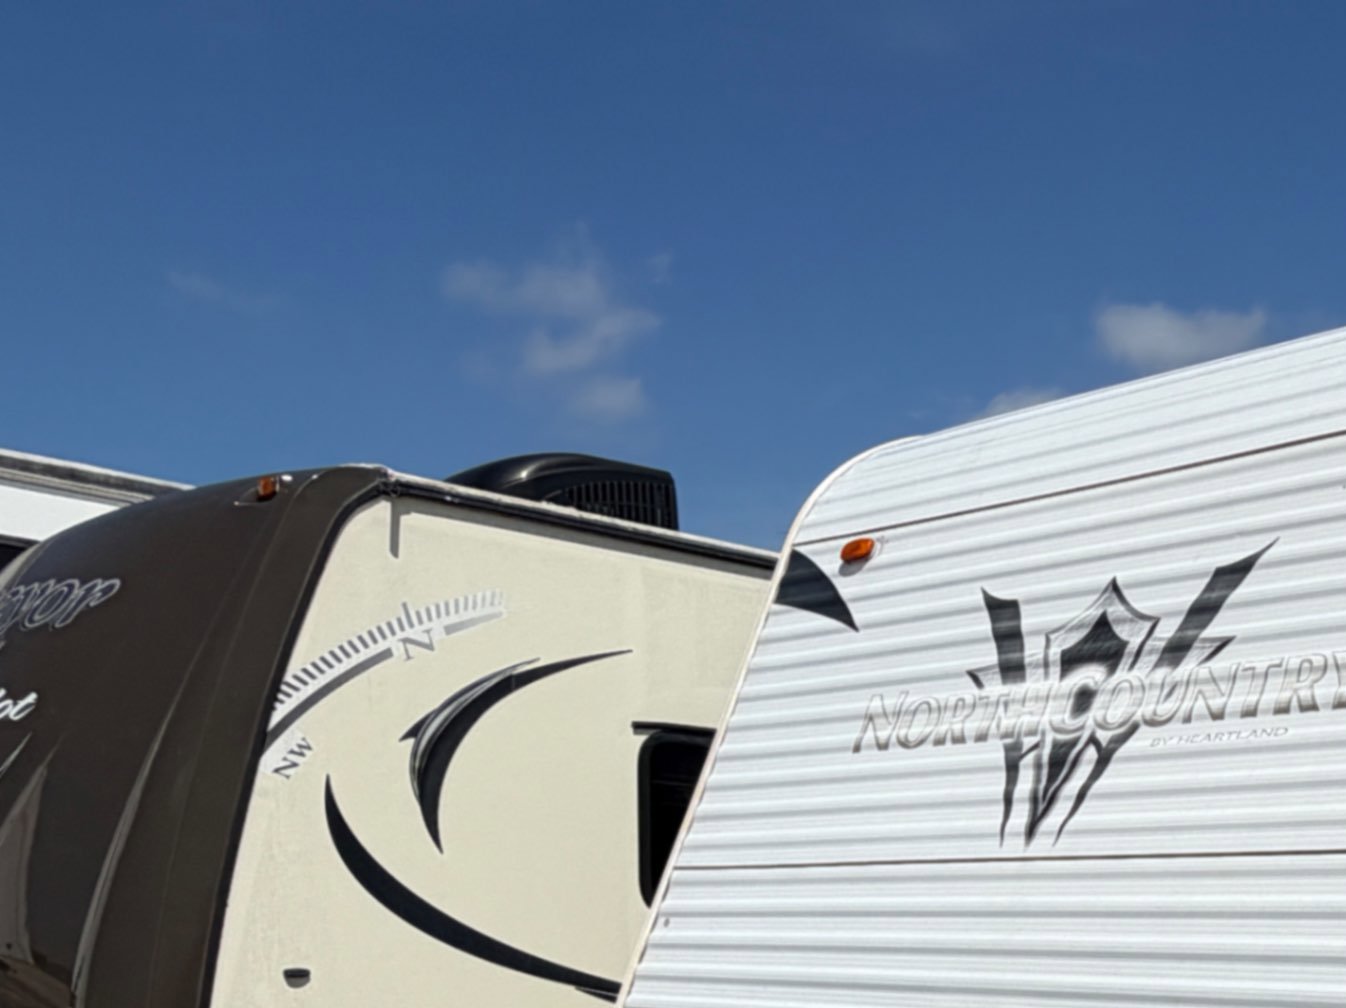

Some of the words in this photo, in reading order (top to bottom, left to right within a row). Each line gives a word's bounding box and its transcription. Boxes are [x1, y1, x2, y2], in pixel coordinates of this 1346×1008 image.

[399, 629, 436, 661] N
[1176, 726, 1290, 745] HEARTLAND
[272, 736, 314, 780] NW
